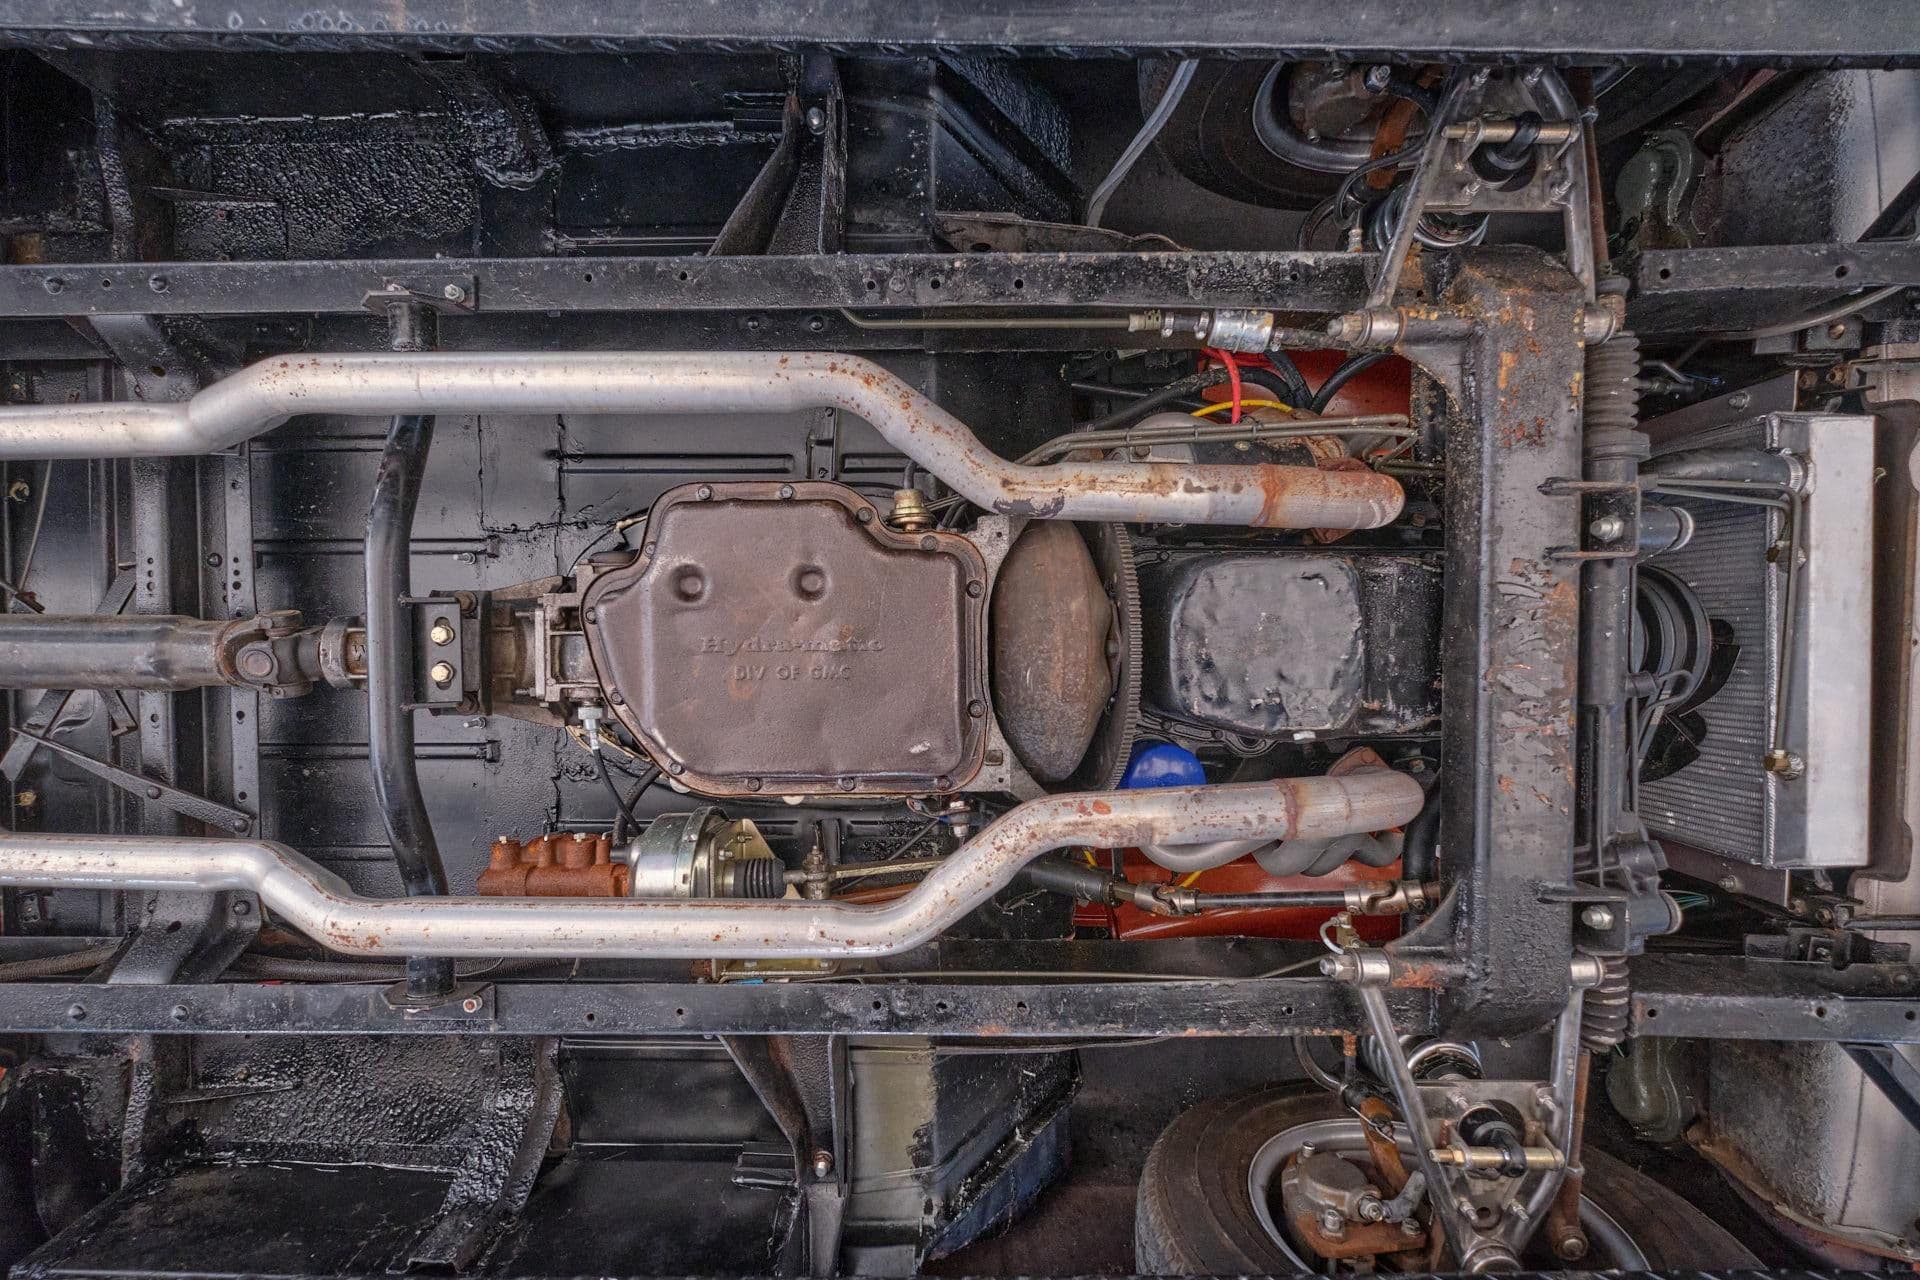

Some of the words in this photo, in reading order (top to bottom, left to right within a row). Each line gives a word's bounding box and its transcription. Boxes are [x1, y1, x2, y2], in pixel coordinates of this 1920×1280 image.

[734, 664, 767, 681] DIV
[775, 664, 801, 680] OF
[809, 664, 852, 681] GMC
